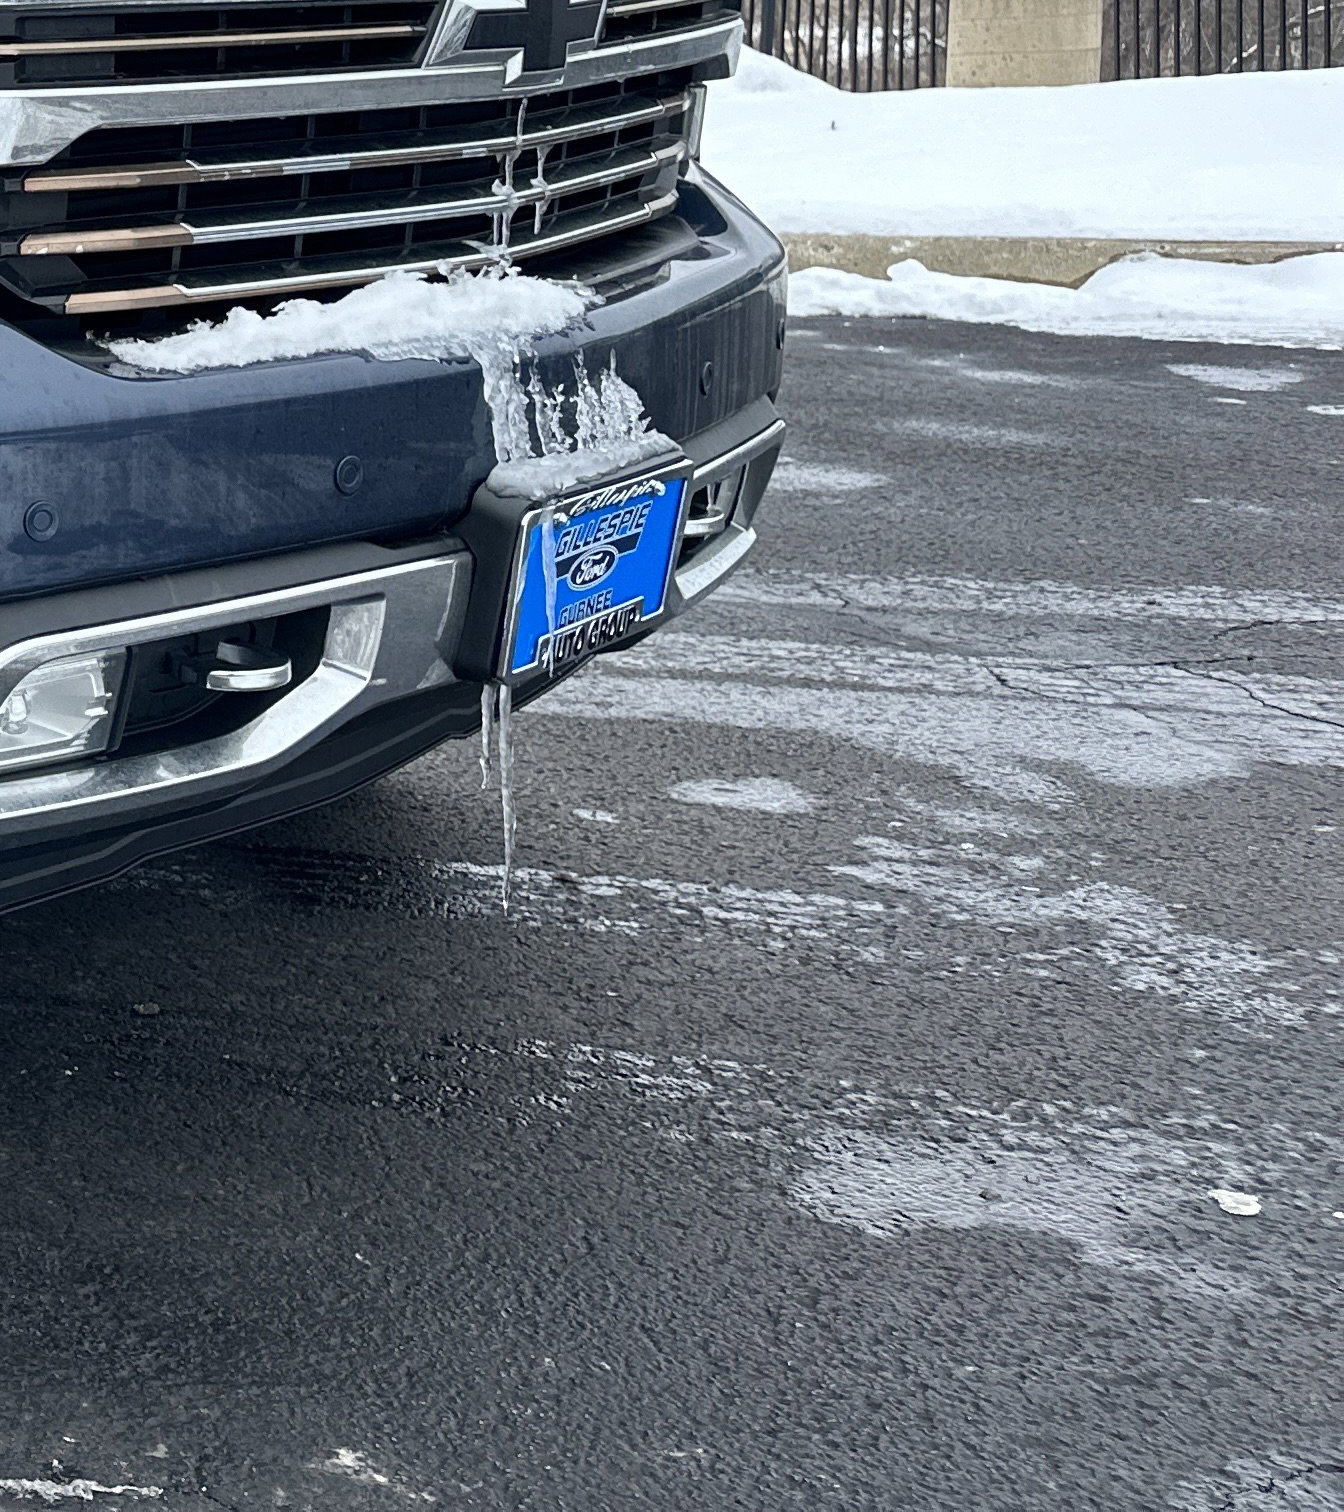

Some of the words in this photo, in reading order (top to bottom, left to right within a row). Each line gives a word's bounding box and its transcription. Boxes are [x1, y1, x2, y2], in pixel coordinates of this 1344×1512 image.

[554, 500, 653, 557] GILLESPIE
[575, 552, 610, 585] Ford
[557, 588, 614, 627] GURNEE
[586, 604, 640, 652] GROUP
